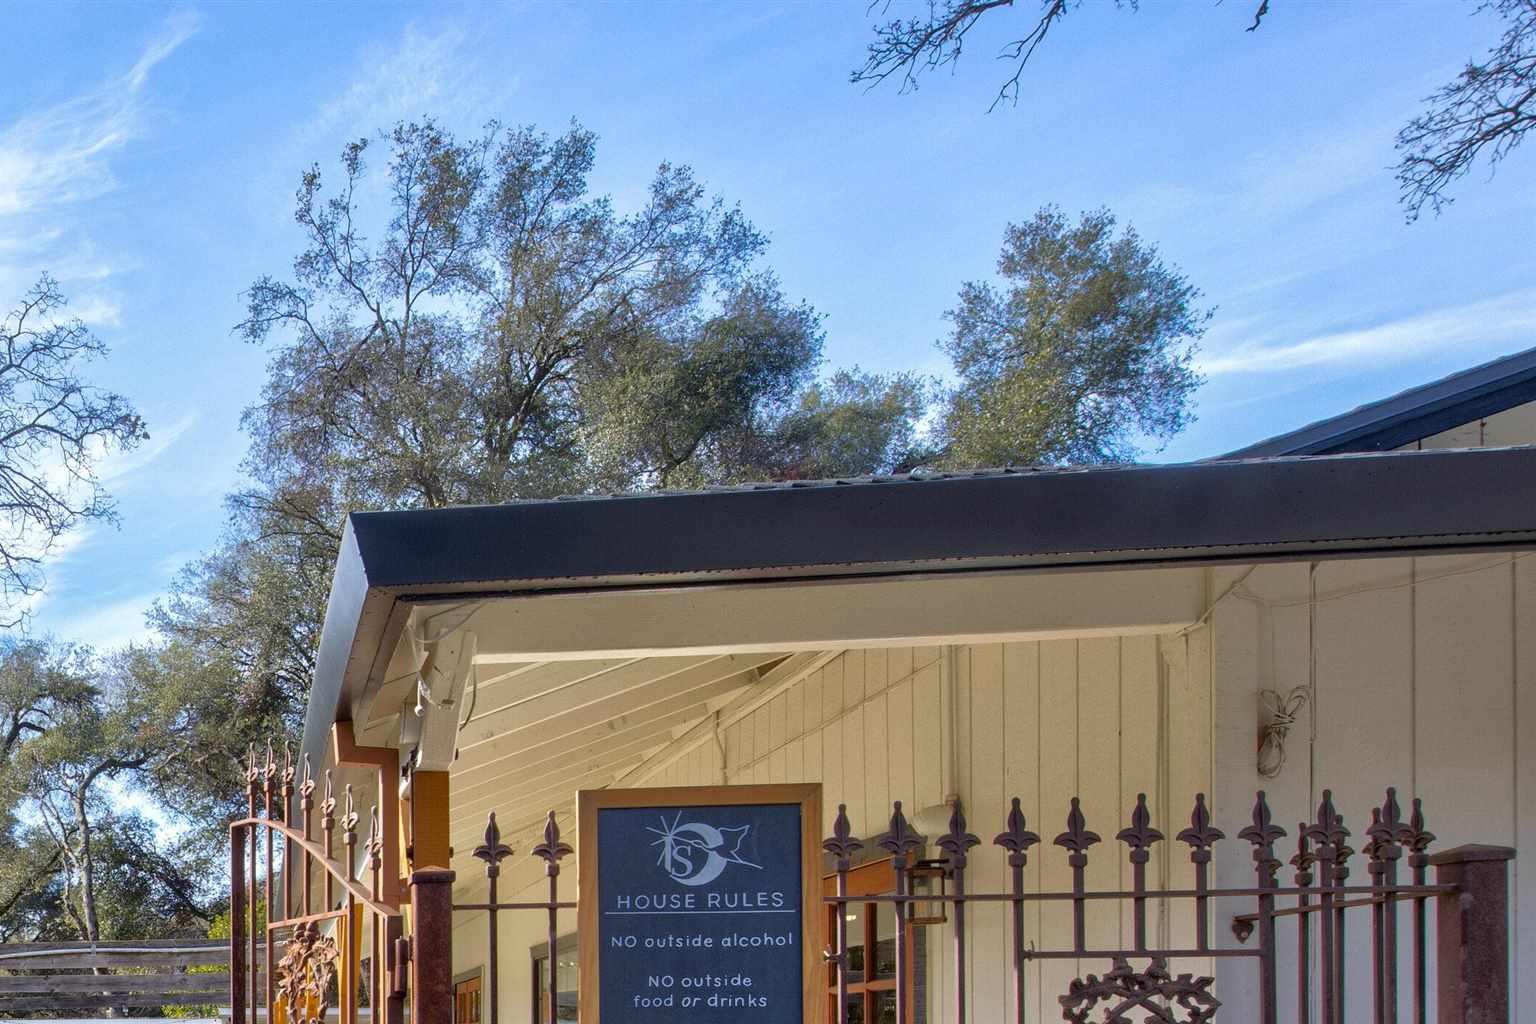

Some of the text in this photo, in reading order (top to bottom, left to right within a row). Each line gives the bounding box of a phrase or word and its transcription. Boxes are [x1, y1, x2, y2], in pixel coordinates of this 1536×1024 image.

[618, 892, 784, 909] HOUSE RULES
[611, 933, 792, 948] NO outside alcohol
[648, 974, 752, 987] NO outside
[634, 994, 767, 1008] food or drinks
